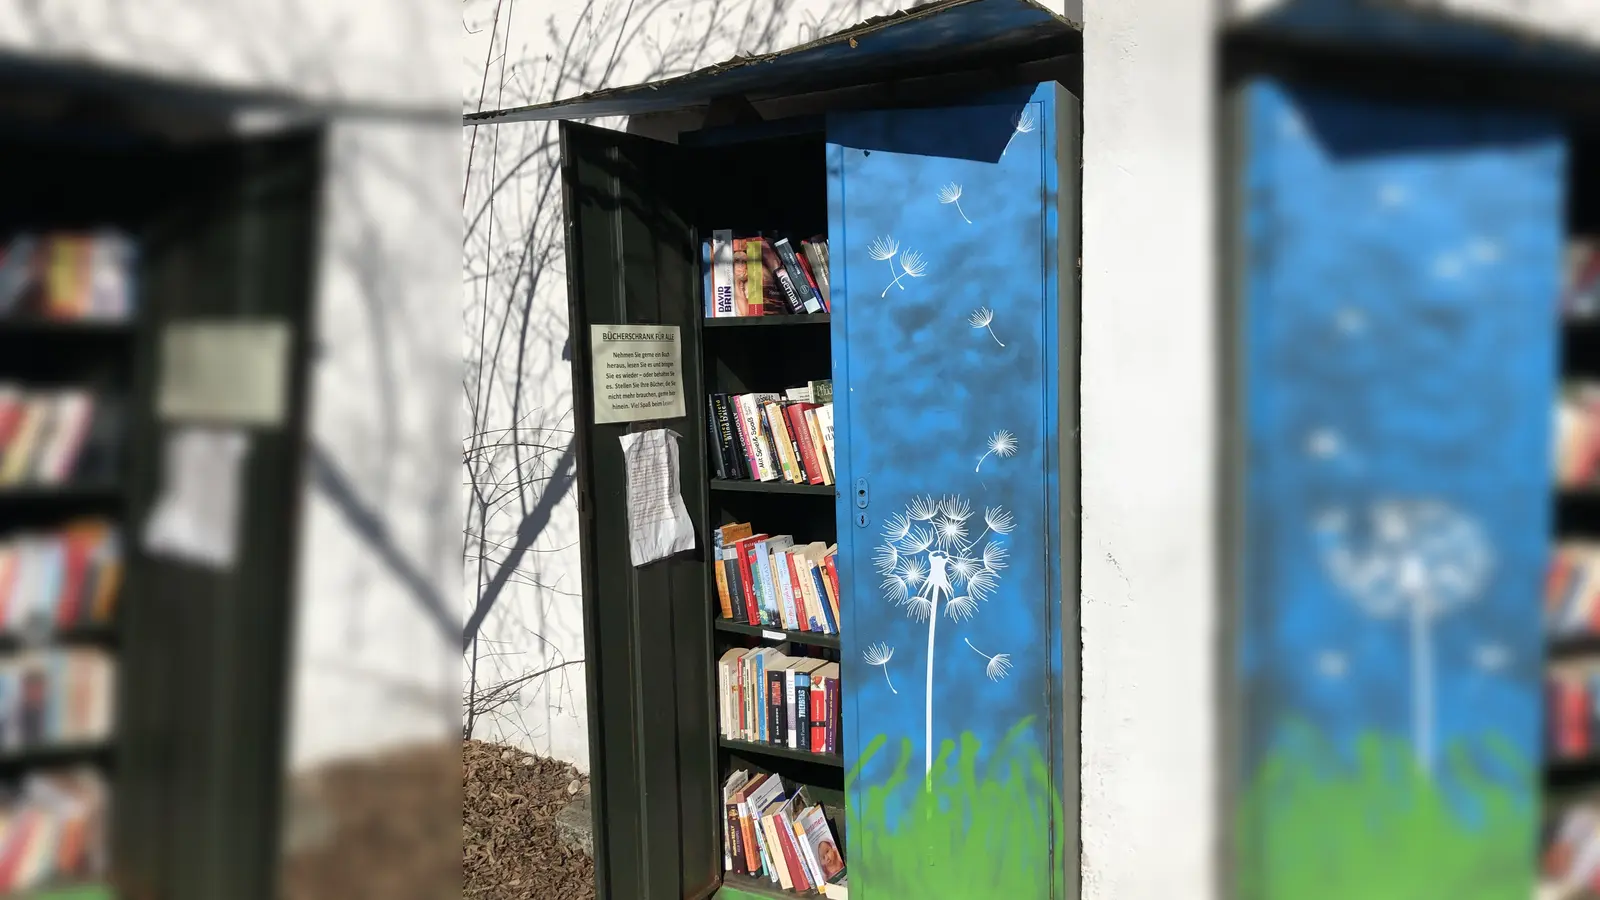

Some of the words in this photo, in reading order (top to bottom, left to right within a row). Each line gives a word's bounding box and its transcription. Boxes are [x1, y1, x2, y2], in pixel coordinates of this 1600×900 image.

[780, 276, 799, 308] German
[602, 331, 654, 340] BÜCHERSCHRANK
[655, 332, 664, 340] FÜR
[640, 401, 651, 409] Spaß
[721, 405, 729, 422] Date
[733, 412, 745, 447] CONNOLLY
